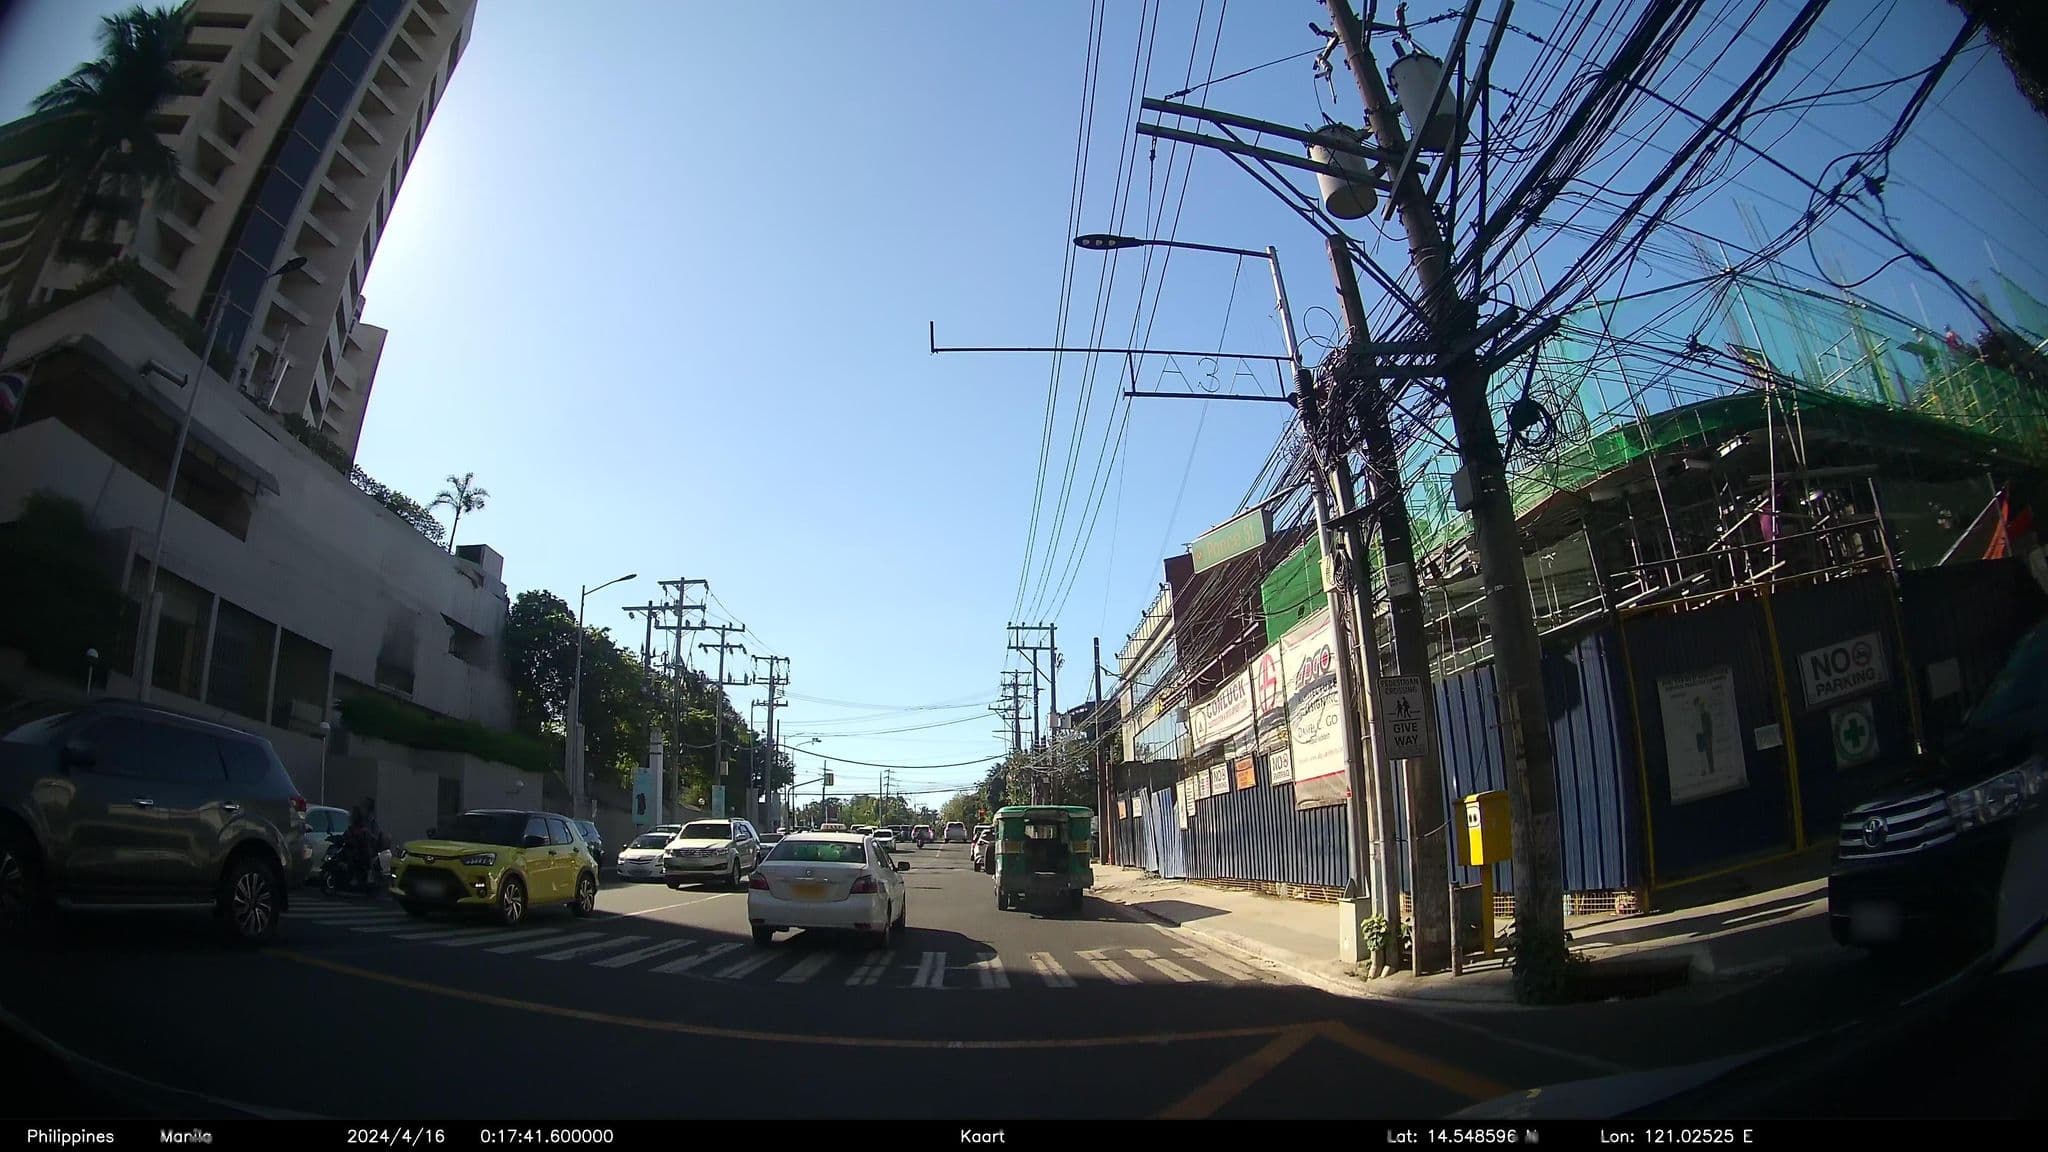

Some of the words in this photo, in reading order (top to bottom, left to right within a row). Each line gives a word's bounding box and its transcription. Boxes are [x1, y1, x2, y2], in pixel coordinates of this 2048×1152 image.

[1811, 648, 1851, 680] NO
[1380, 677, 1419, 688] PEDESTRIAN
[1816, 667, 1875, 697] PARKING
[1385, 686, 1418, 696] CROSSING
[1393, 722, 1418, 734] GIVE
[1394, 734, 1418, 746] WAY
